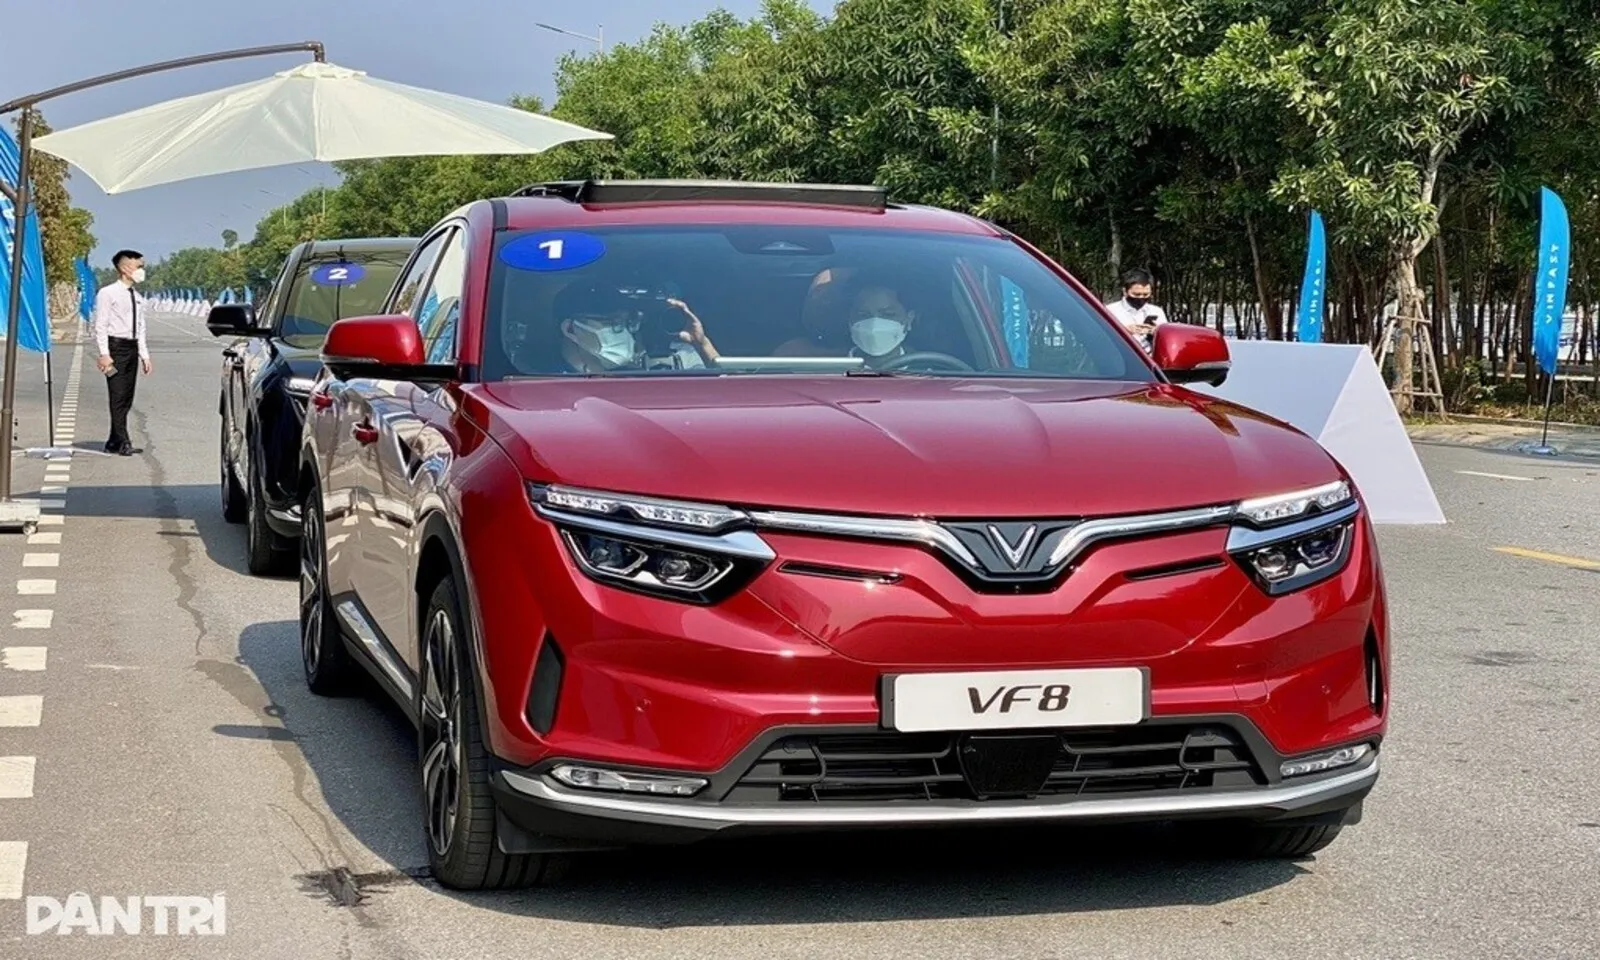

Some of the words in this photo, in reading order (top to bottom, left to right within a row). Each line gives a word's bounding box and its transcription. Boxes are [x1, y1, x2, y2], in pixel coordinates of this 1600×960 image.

[538, 239, 564, 259] 1
[328, 268, 348, 280] 2
[967, 684, 1071, 714] VF8
